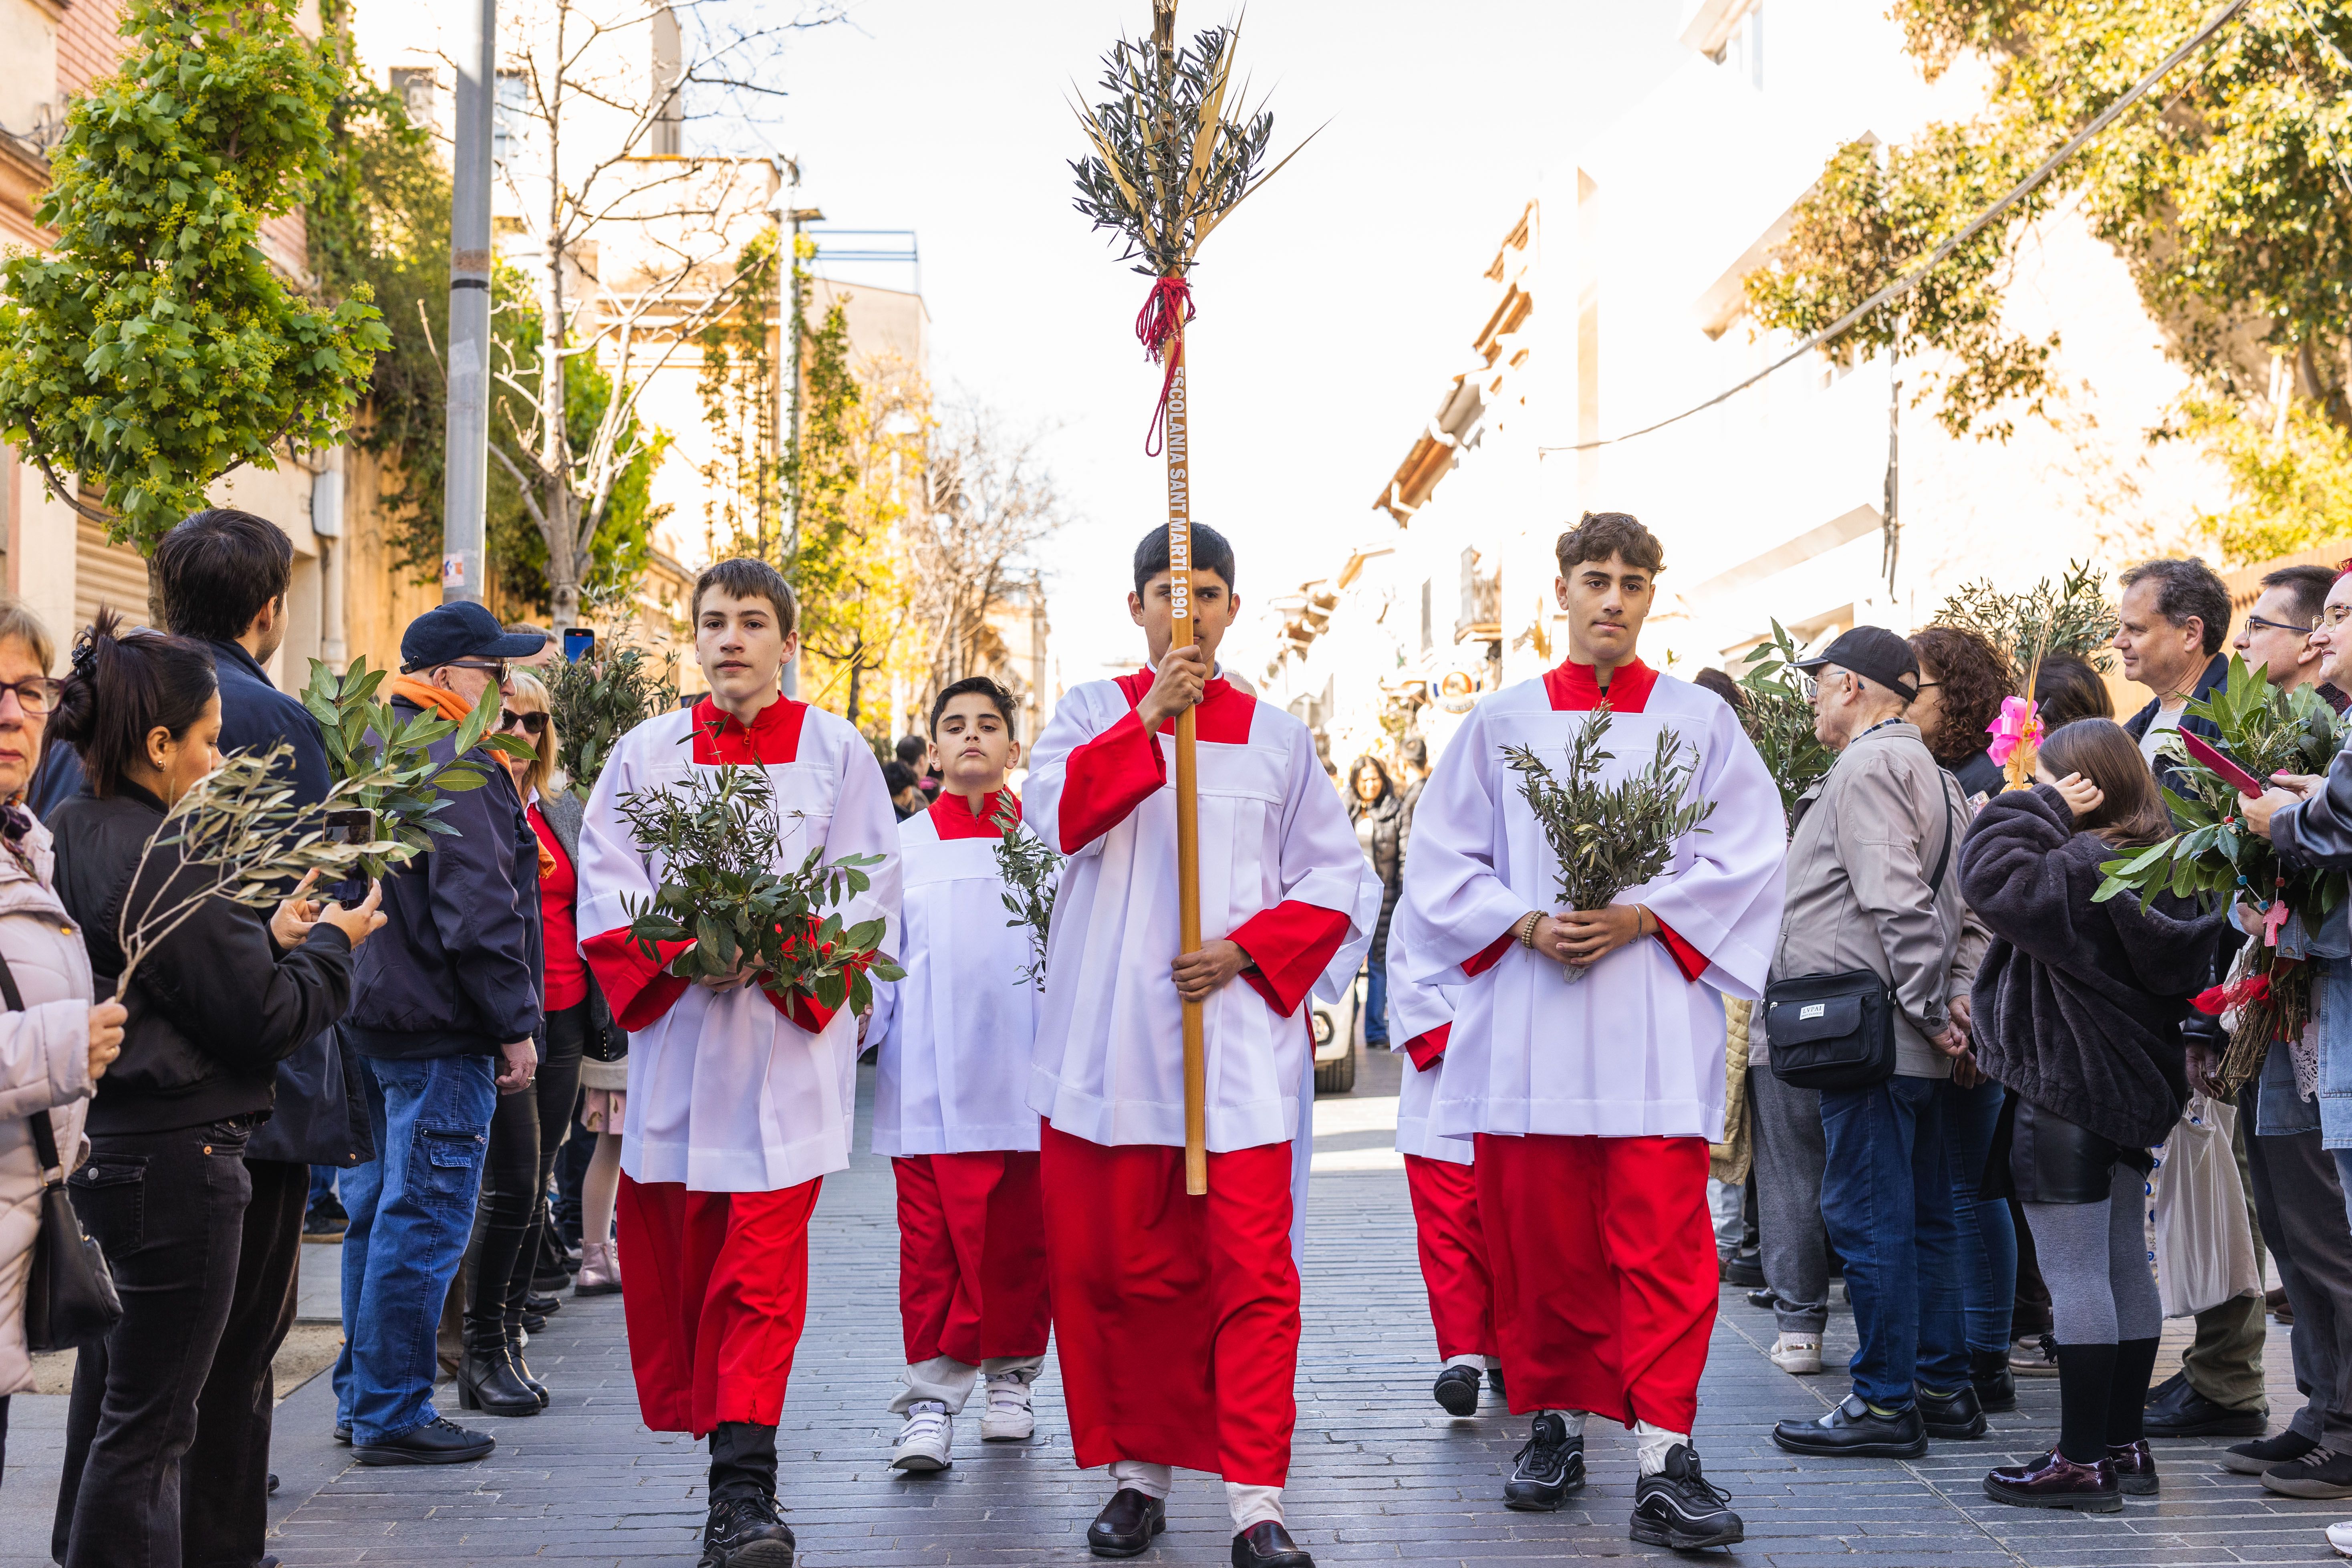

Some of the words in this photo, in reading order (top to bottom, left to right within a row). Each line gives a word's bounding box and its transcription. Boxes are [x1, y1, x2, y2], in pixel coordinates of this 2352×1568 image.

[1168, 366, 1186, 464] ESCOLANIA
[1170, 468, 1187, 513] SANT
[1171, 518, 1191, 572] MARTÍ
[1171, 576, 1188, 619] 1990
